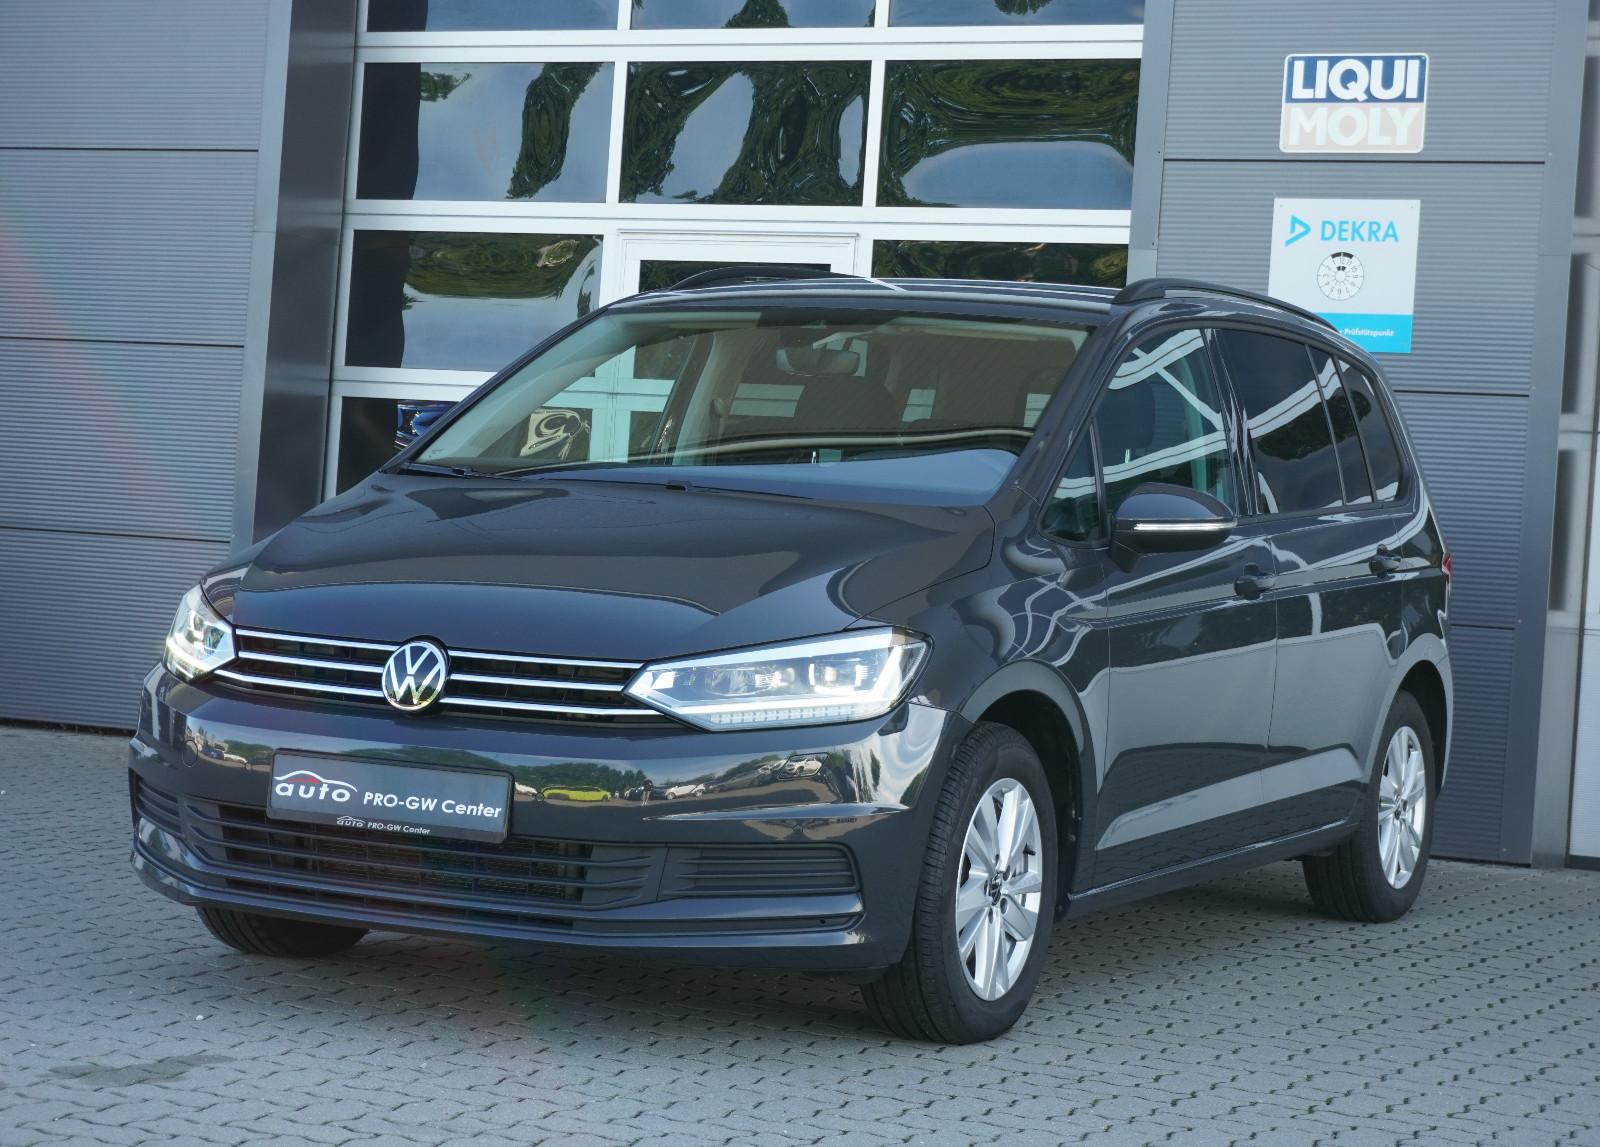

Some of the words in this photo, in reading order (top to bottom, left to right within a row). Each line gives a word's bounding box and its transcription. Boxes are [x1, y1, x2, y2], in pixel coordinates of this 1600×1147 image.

[1291, 58, 1420, 102] LIQUI
[1287, 106, 1420, 146] MOLY
[1320, 220, 1399, 242] DEKRA
[275, 782, 351, 802] auto
[363, 791, 438, 812] PRO-GW
[441, 799, 502, 818] Center
[336, 819, 364, 828] auto
[367, 821, 402, 832] PRO-GW
[403, 825, 431, 835] Center
